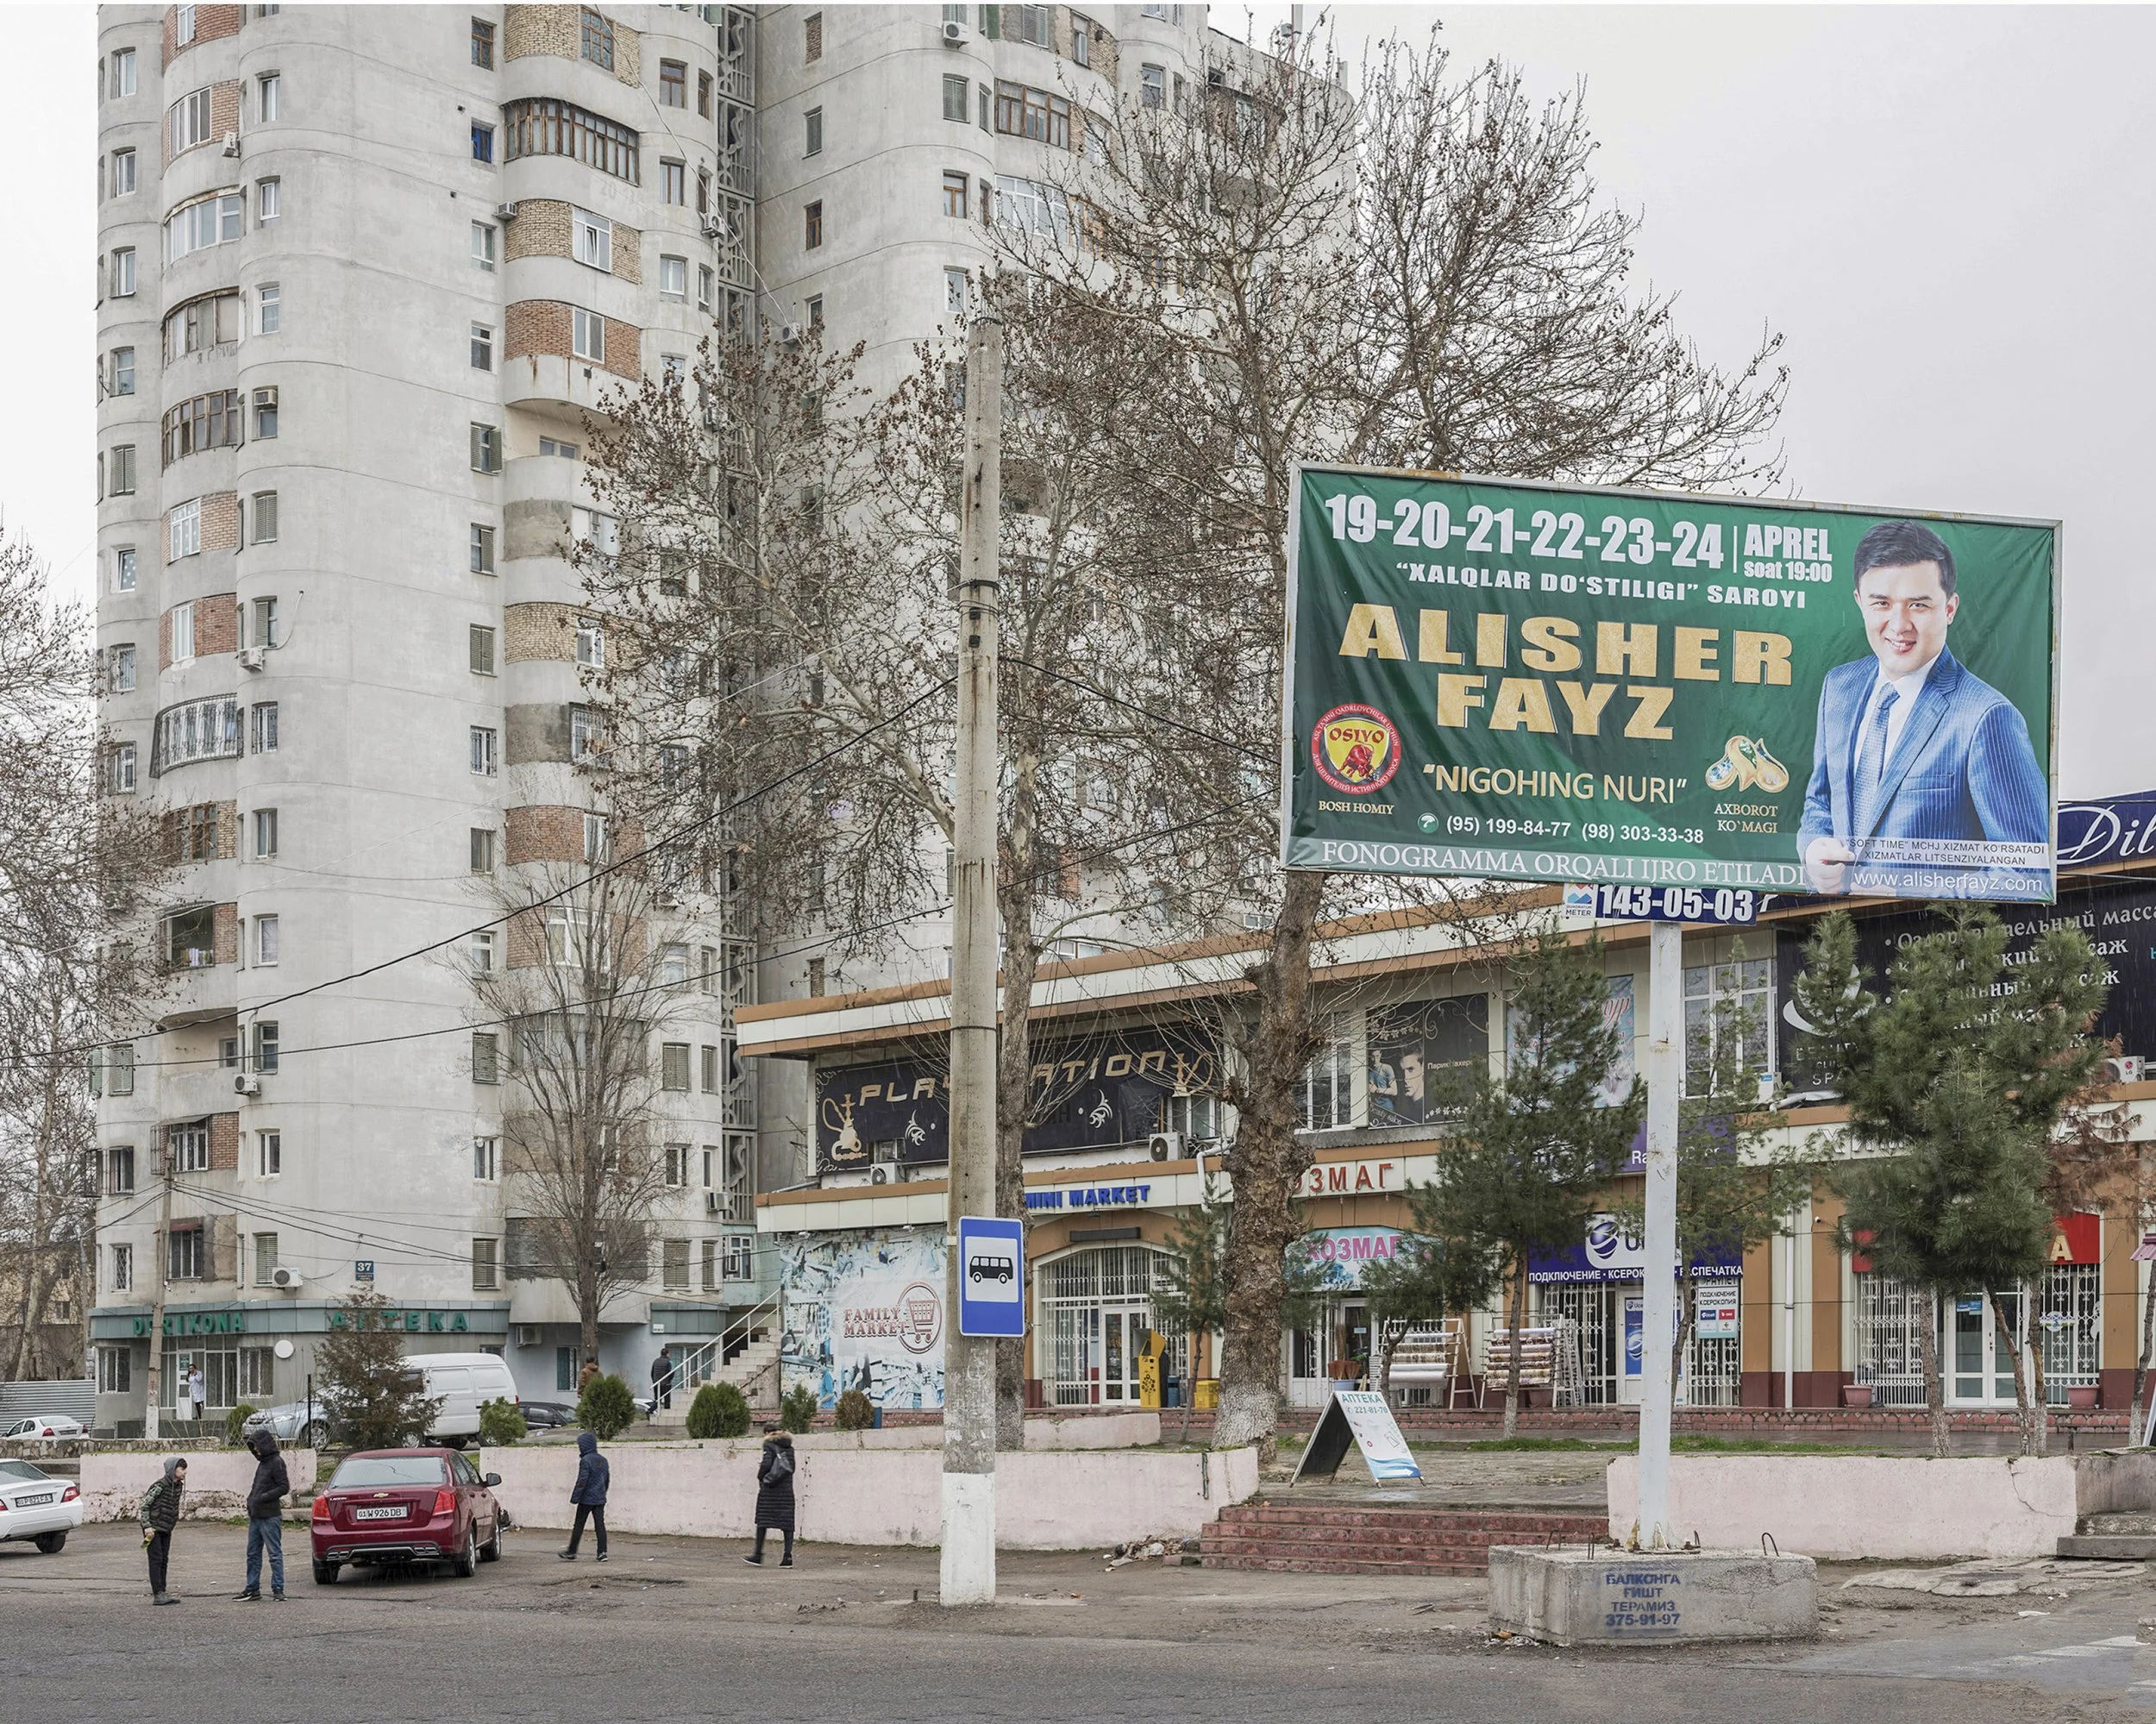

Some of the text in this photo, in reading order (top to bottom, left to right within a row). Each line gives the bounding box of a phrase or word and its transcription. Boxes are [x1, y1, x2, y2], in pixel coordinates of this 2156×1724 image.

[1326, 493, 1723, 569] 19-20-21-22-23-24
[1744, 523, 1833, 561] APREL
[1744, 561, 1833, 583] soat 19:00
[1707, 585, 1806, 609] SAROYI
[1338, 603, 1794, 686] ALISHER
[1437, 673, 1675, 741] FAYZ
[1329, 727, 1384, 743] OSIYO
[1319, 800, 1395, 814] BOSH HOMIY
[1714, 803, 1778, 817] AXBOROT
[1446, 815, 1704, 844] (95) 199-84-77 (98) 303-33-38
[1912, 842, 1940, 850] MCHJ
[1943, 843, 1980, 852] XIZMAT
[1322, 842, 1806, 886] FONOGRAMMA ORQALI IJRO ETILADI
[1865, 850, 2026, 865] XIZMATLAR LITSENZIYALANGAN
[1854, 869, 2043, 893] www.alisherfayz.com
[1599, 884, 1753, 922] 143-05-03
[1025, 1184, 1150, 1208] MINI MARKET
[357, 1262, 372, 1272] 37
[1529, 1269, 1601, 1282] ПОДКЛЮЧЕНИЕ
[844, 1307, 901, 1321] FAMILY
[843, 1321, 908, 1338] MARKET
[1342, 1394, 1383, 1403] АПТЕКА
[1606, 1574, 1681, 1585] БАЛКОНГА
[1611, 1602, 1676, 1612] ТЕРАМИЗ
[1606, 1613, 1681, 1627] 375-91-97
